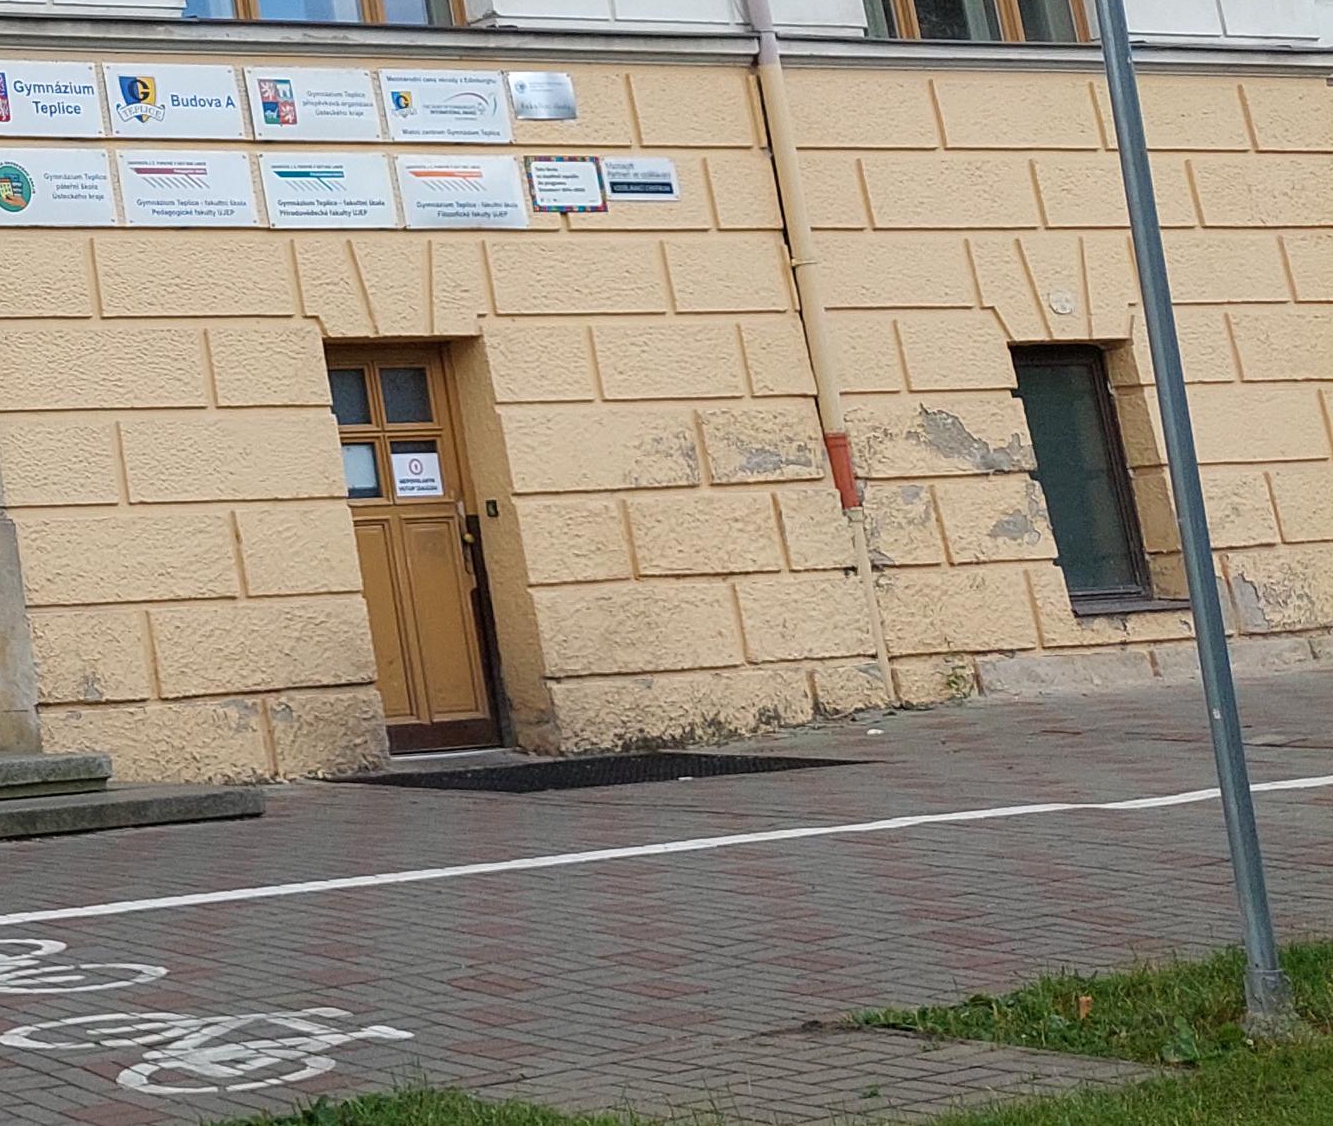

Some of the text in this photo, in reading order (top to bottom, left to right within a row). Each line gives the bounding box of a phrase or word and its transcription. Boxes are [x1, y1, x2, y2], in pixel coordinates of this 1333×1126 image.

[13, 80, 95, 97] Gymnázium
[128, 79, 151, 102] G
[307, 90, 365, 99] Gymnázium Teplice
[170, 94, 236, 109] Budova A
[32, 100, 82, 117] Teplice
[121, 105, 164, 120] TEPLICE
[43, 172, 107, 181] Gymnázium Teplice
[88, 193, 104, 201] kraje
[136, 198, 175, 207] Gymnázium
[177, 199, 200, 207] Teplice
[277, 199, 315, 208] Gymnázium
[316, 199, 338, 207] Teplice
[416, 201, 454, 209] Gymnázium
[455, 201, 477, 209] Teplice
[151, 209, 193, 217] Pedagogické
[194, 209, 216, 217] fakulty
[329, 209, 352, 217] fakulty
